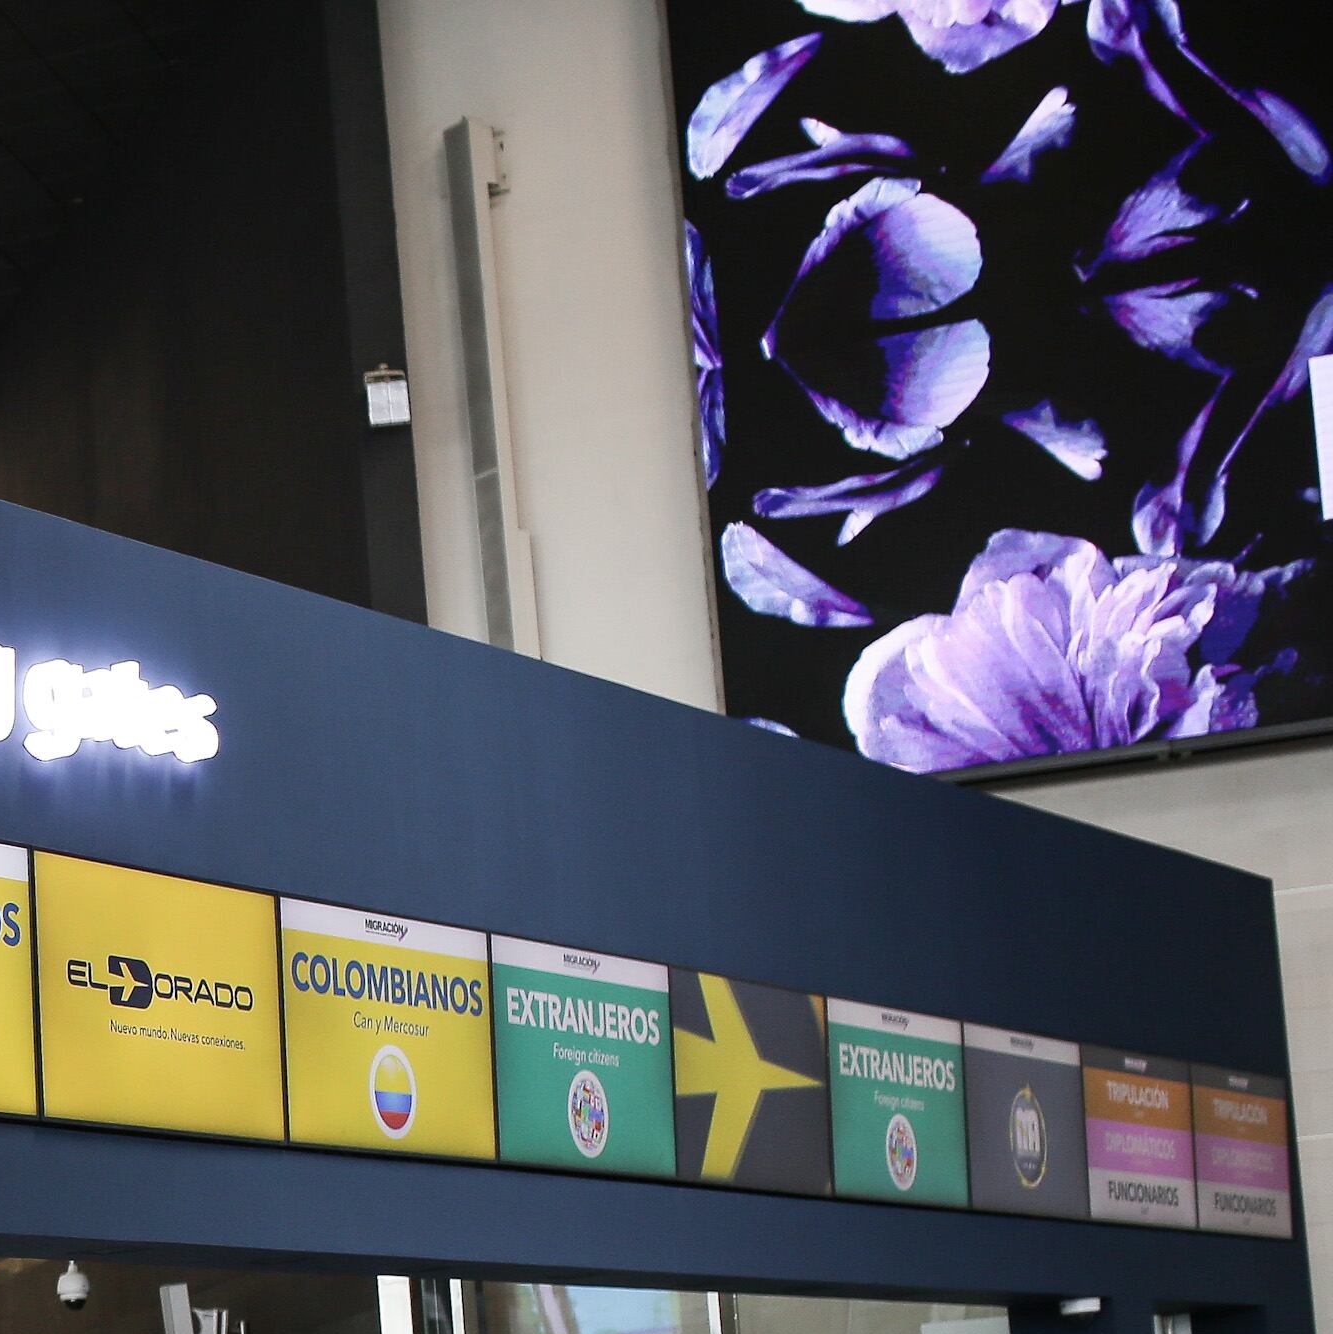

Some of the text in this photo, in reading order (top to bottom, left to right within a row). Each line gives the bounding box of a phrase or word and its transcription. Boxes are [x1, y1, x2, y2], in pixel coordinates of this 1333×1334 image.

[23, 658, 220, 762] gates
[365, 918, 403, 935] MIGRACIÓN
[67, 960, 109, 990] EL
[291, 952, 483, 1016] COLOMBIANOS
[353, 1011, 429, 1037] Can y Mercosur
[506, 986, 660, 1046] EXTRANJEROS
[110, 1019, 245, 1050] Nuevo mundo. Nuevas conexiones.
[553, 1042, 619, 1067] Foreign citizens
[839, 1042, 956, 1092] EXTRANJEROS
[1109, 1181, 1179, 1207] FUNCIONARIOS
